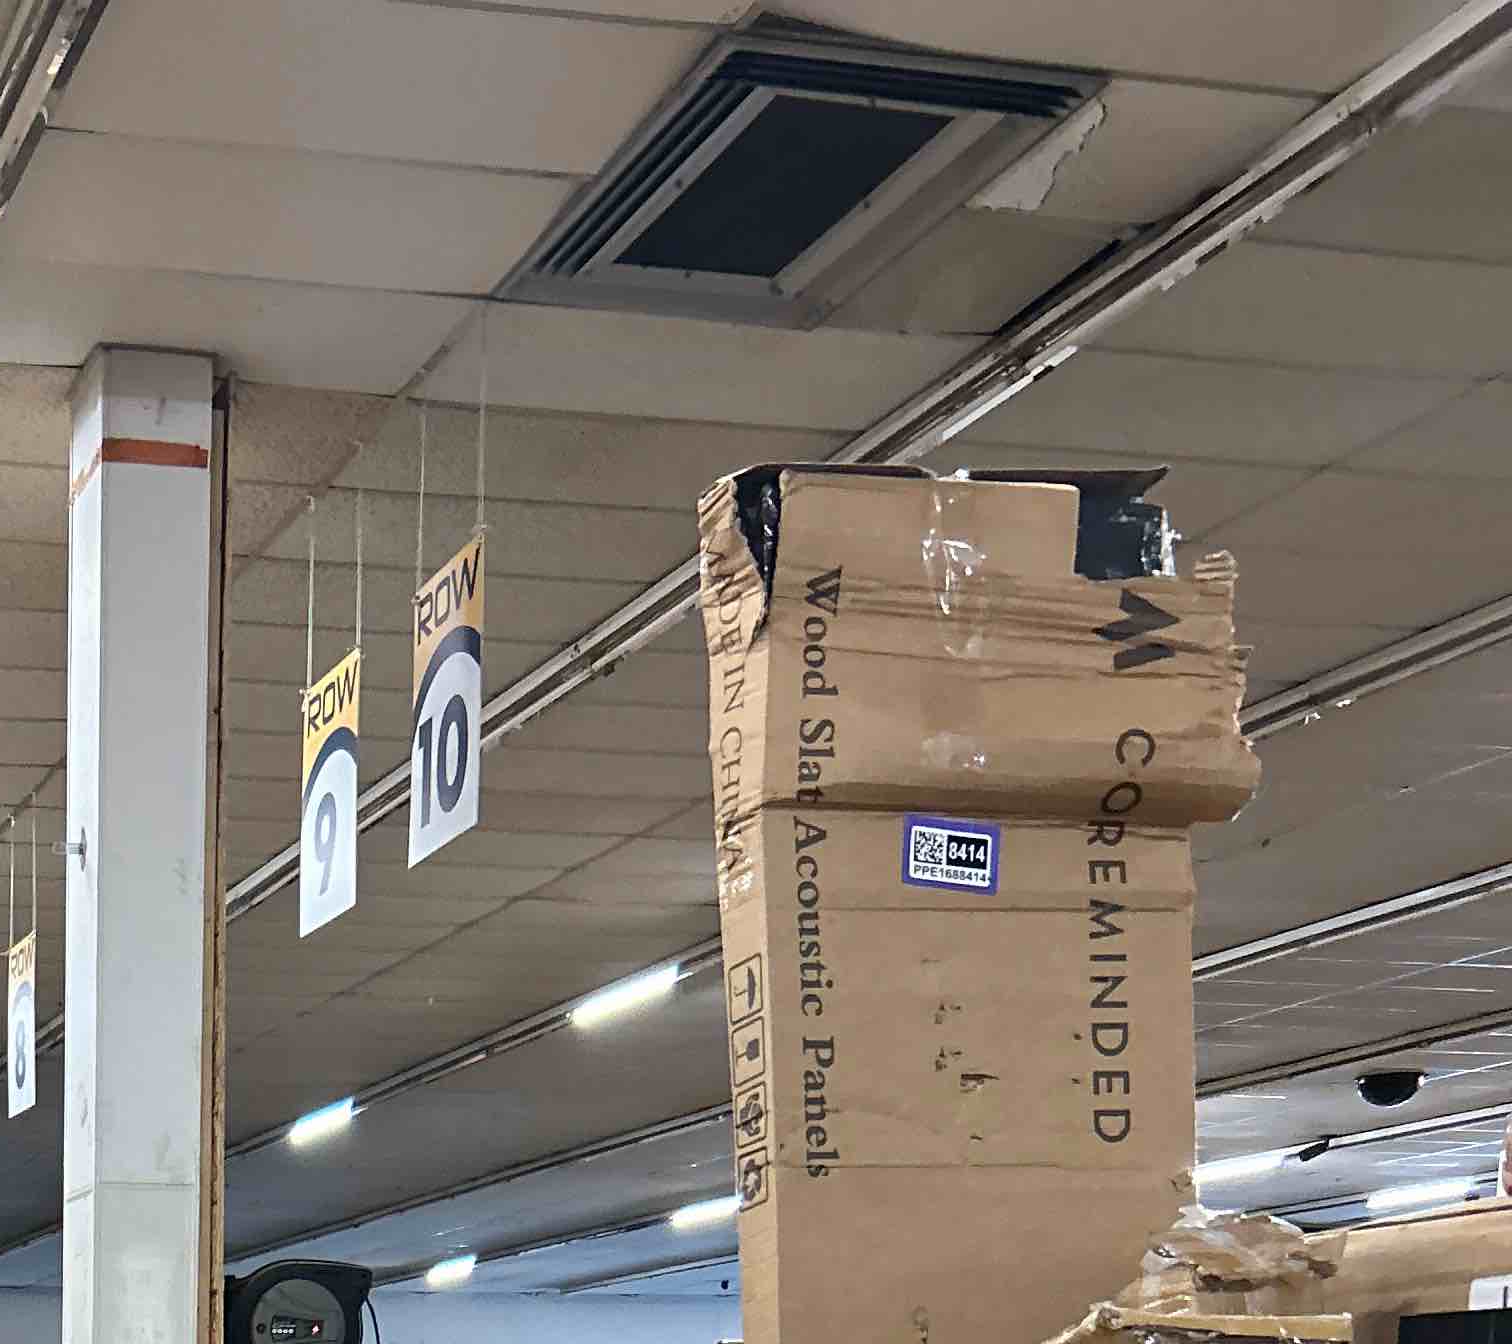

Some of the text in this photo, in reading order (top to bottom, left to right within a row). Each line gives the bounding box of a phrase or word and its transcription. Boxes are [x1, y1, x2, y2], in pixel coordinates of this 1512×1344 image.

[416, 546, 481, 646] ROW
[306, 660, 358, 738] ROW
[723, 662, 746, 715] IN
[417, 694, 469, 830] 10
[313, 791, 338, 898] 9
[792, 565, 844, 1179] Wood Slat Acoustic Panels
[913, 864, 987, 883] PPE1688414
[948, 841, 986, 863] 8414
[9, 941, 36, 980] ROW
[15, 1019, 27, 1092] 8
